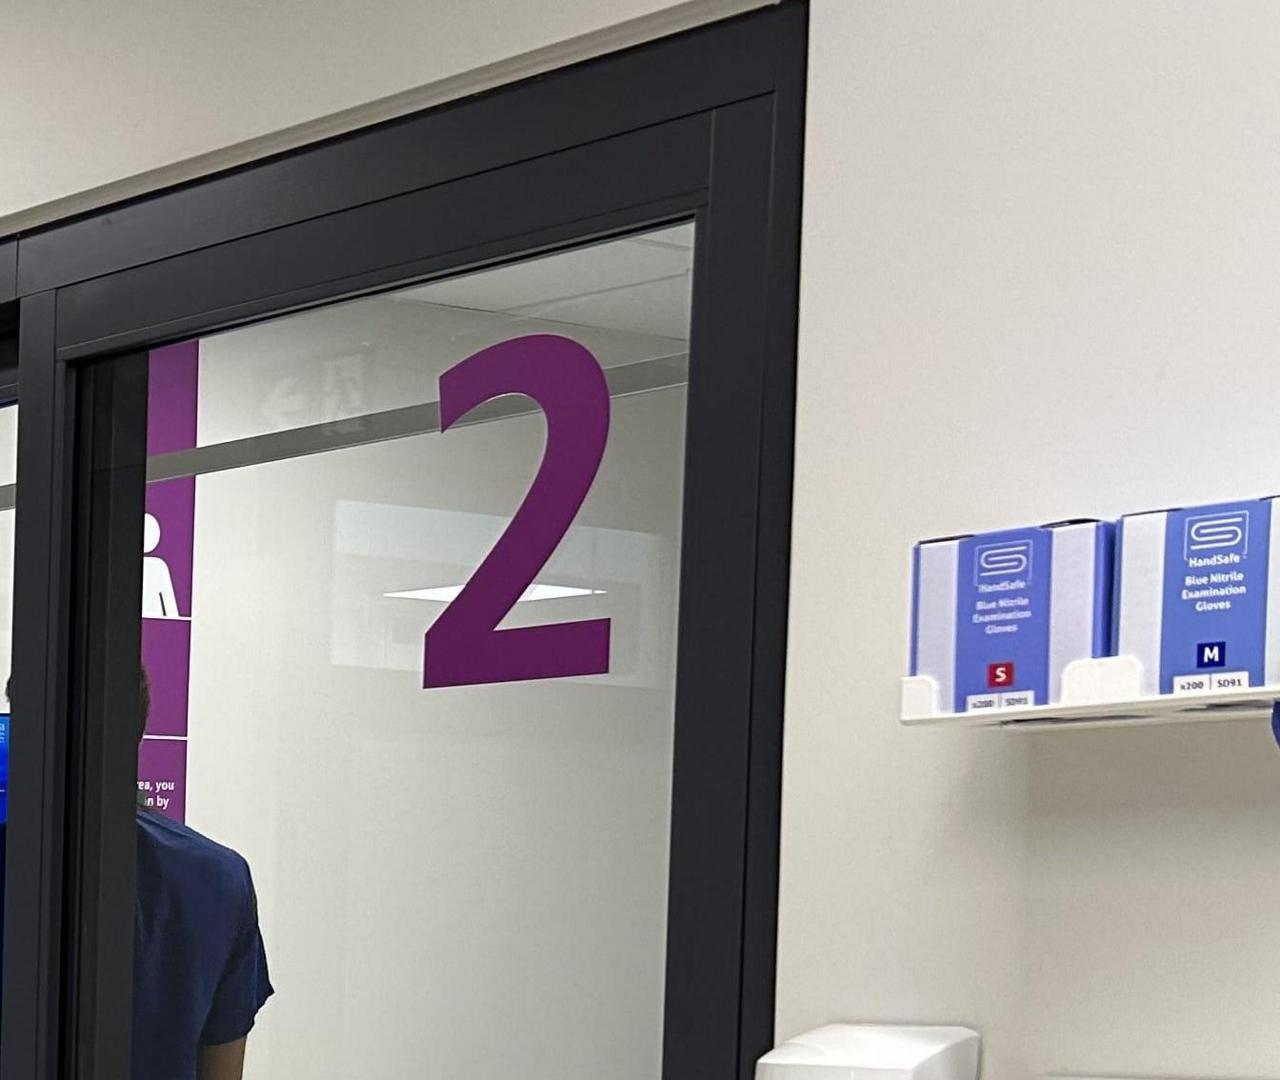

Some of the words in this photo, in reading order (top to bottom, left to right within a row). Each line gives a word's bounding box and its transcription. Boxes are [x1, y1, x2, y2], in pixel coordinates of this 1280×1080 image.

[422, 333, 611, 690] 2
[1188, 552, 1241, 568] HandSafe
[1184, 574, 1209, 586] Blue
[1210, 571, 1245, 583] Nitrile
[1181, 585, 1247, 600] Examination
[1195, 600, 1232, 612] Gloves
[1203, 647, 1219, 662] M
[995, 667, 1007, 682] S
[155, 781, 175, 793] you
[156, 794, 170, 810] by
